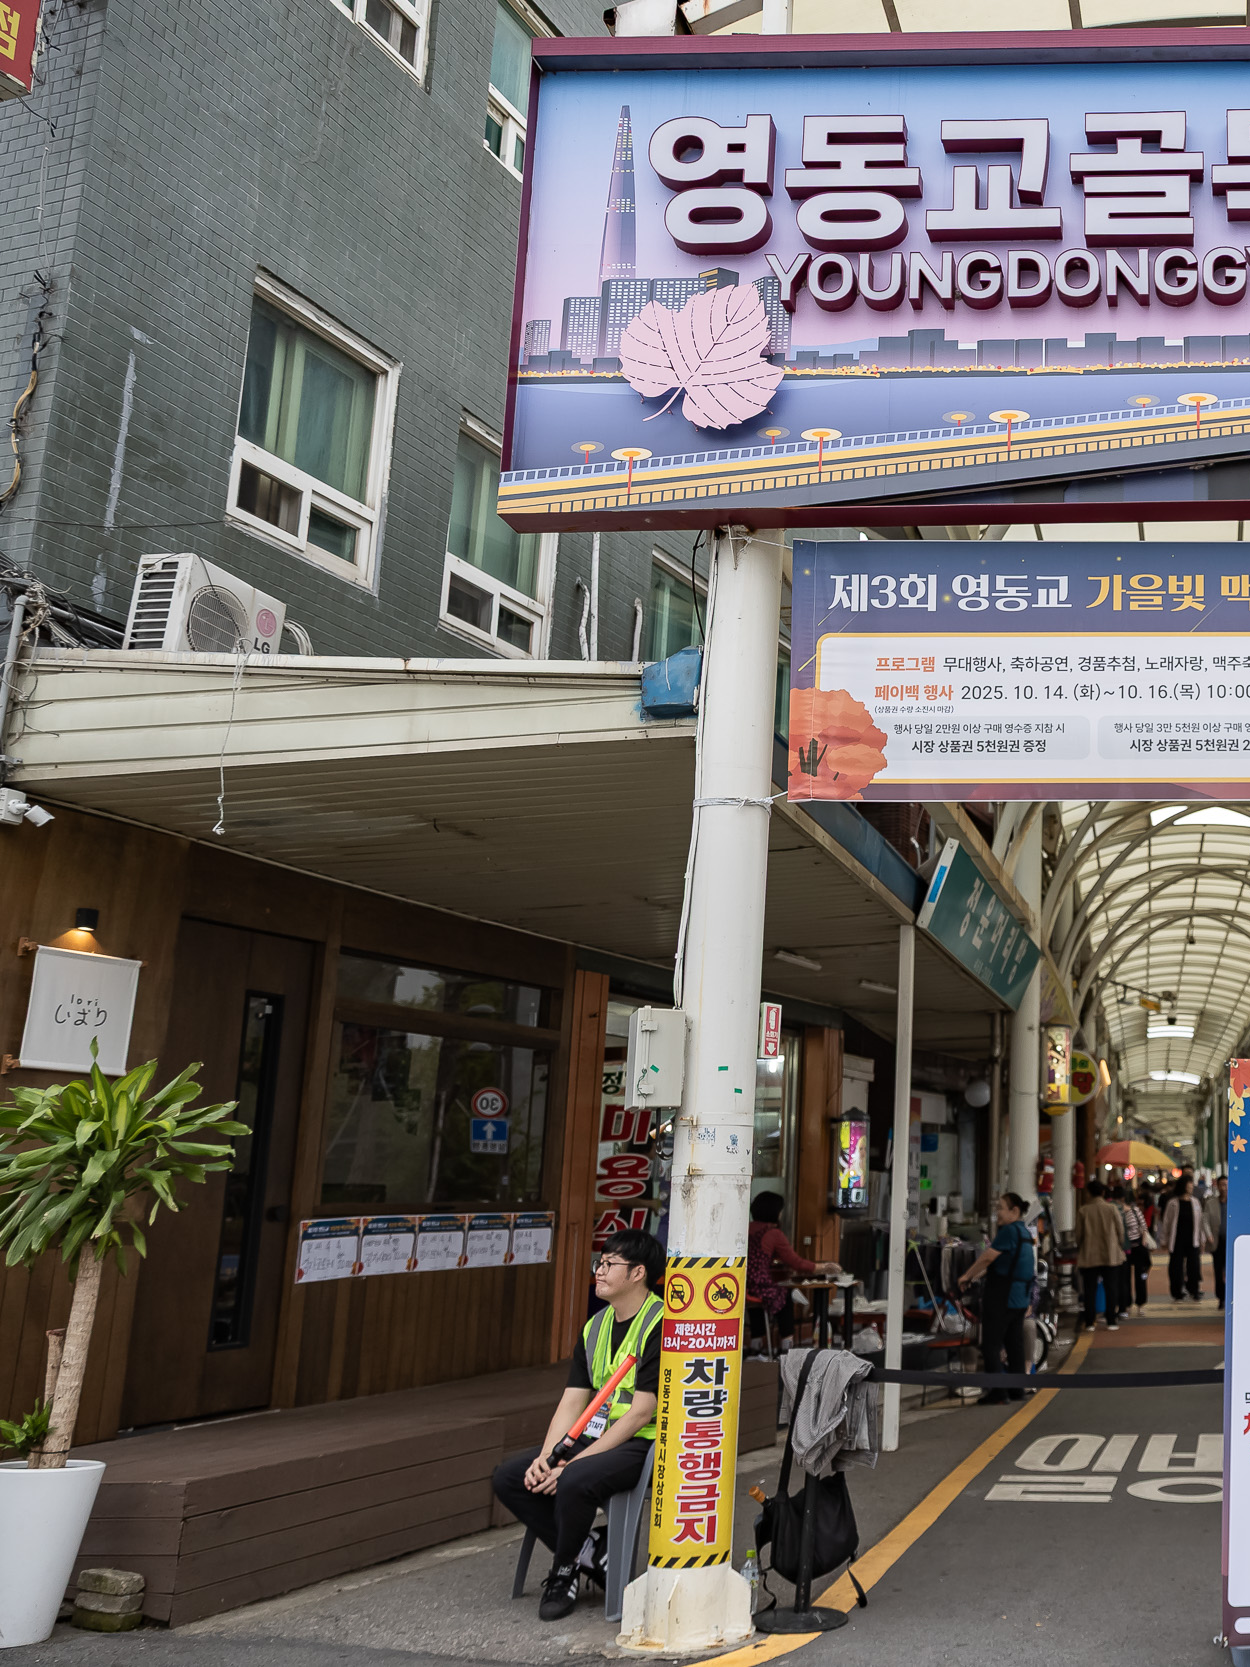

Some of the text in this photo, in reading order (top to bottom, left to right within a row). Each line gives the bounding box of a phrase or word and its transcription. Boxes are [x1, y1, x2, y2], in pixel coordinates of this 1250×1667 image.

[828, 573, 937, 612] 제3회
[951, 573, 1072, 612] 영동교
[1086, 573, 1206, 612] 가을빛
[254, 637, 270, 654] LG
[875, 657, 935, 672] 프로그램
[943, 656, 1006, 673] 무대행사,
[1010, 656, 1073, 673] 축하공연,
[1078, 656, 1141, 672] 경품추첨,
[1145, 656, 1207, 672] 노래자랑,
[875, 685, 919, 701] 페이백
[924, 685, 953, 701] 행사
[961, 686, 1007, 700] 2025.
[1014, 686, 1037, 700] 10.
[1044, 686, 1067, 700] 14.
[894, 723, 1065, 734] 행사 당일 2만원 이상 구매 영수증 지참 시
[1114, 722, 1132, 733] 행사
[1135, 722, 1153, 733] 당일
[1156, 722, 1172, 733] 3만
[1175, 722, 1200, 733] 5천원
[1203, 722, 1221, 733] 이상
[1224, 722, 1242, 733] 구매
[912, 740, 1046, 754] 시장 상품권 5천원권 증정
[1130, 739, 1153, 752] 시장
[1156, 739, 1192, 752] 상품권
[1195, 739, 1239, 752] 5천원권
[675, 1323, 716, 1336] 제한시간
[664, 1335, 736, 1350] 13시~20시까지
[654, 1368, 671, 1528] 영동교골목시장상인회
[670, 1356, 730, 1546] 차량통행금지
